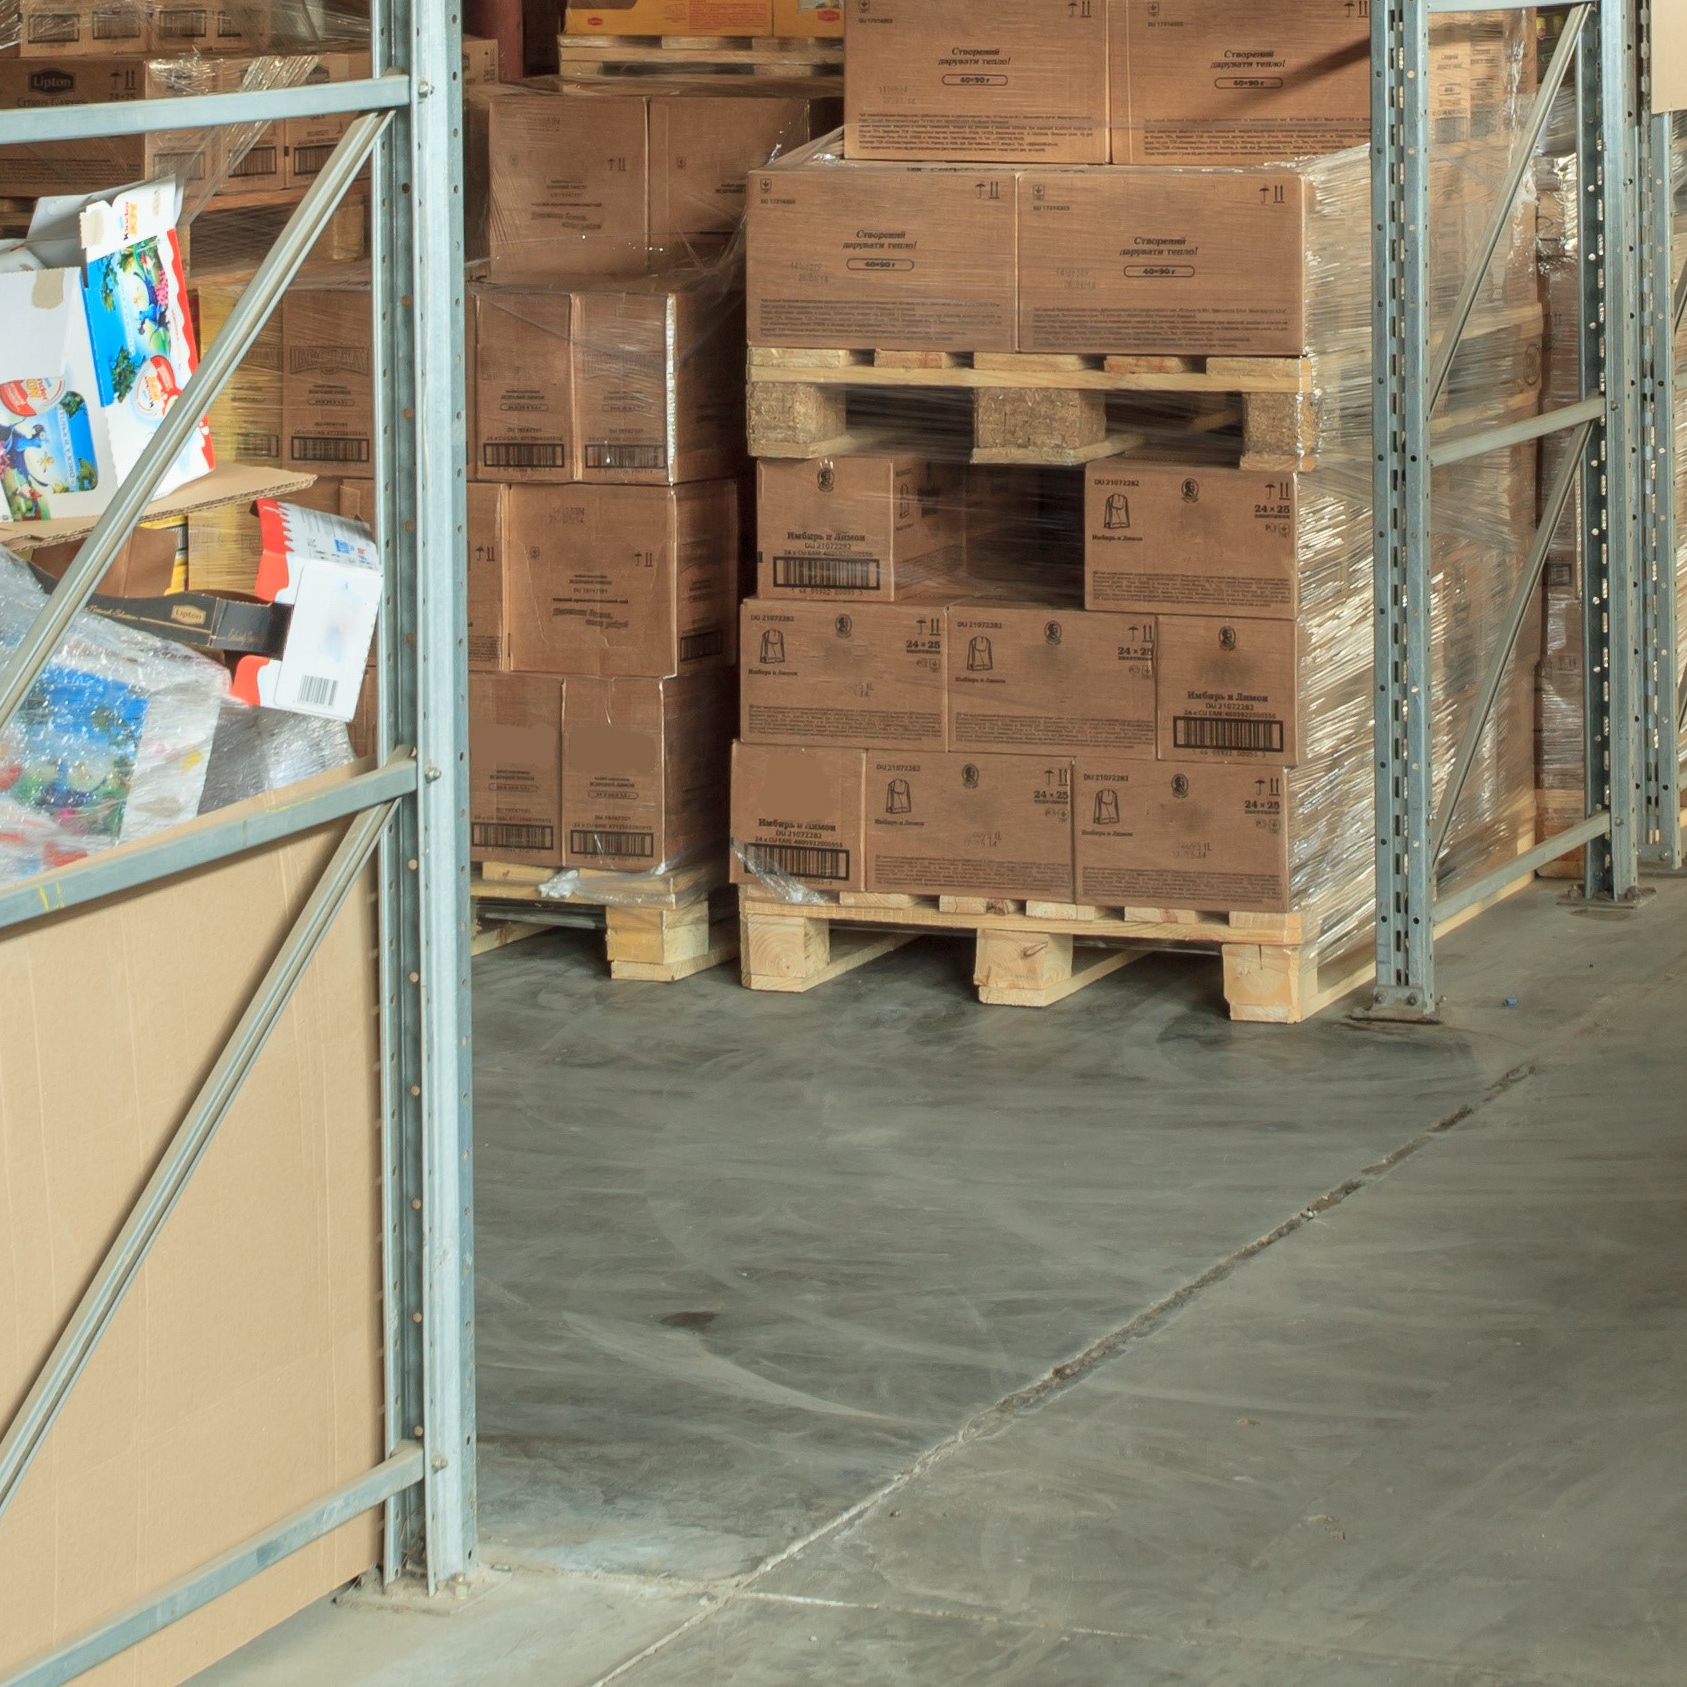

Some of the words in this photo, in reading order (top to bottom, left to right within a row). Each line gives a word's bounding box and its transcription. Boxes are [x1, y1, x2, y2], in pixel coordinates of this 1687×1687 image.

[951, 46, 1001, 58] Створений
[1223, 49, 1274, 61] Створений
[31, 74, 71, 90] Lipton
[856, 229, 907, 241] Створений
[1133, 236, 1187, 248] Створений
[1094, 479, 1104, 487] DU
[1105, 479, 1140, 488] 21072282
[787, 531, 825, 542] Имбирь
[175, 606, 203, 622] Lipton
[1187, 691, 1226, 702] Имбирь
[758, 817, 795, 830] Имбирь
